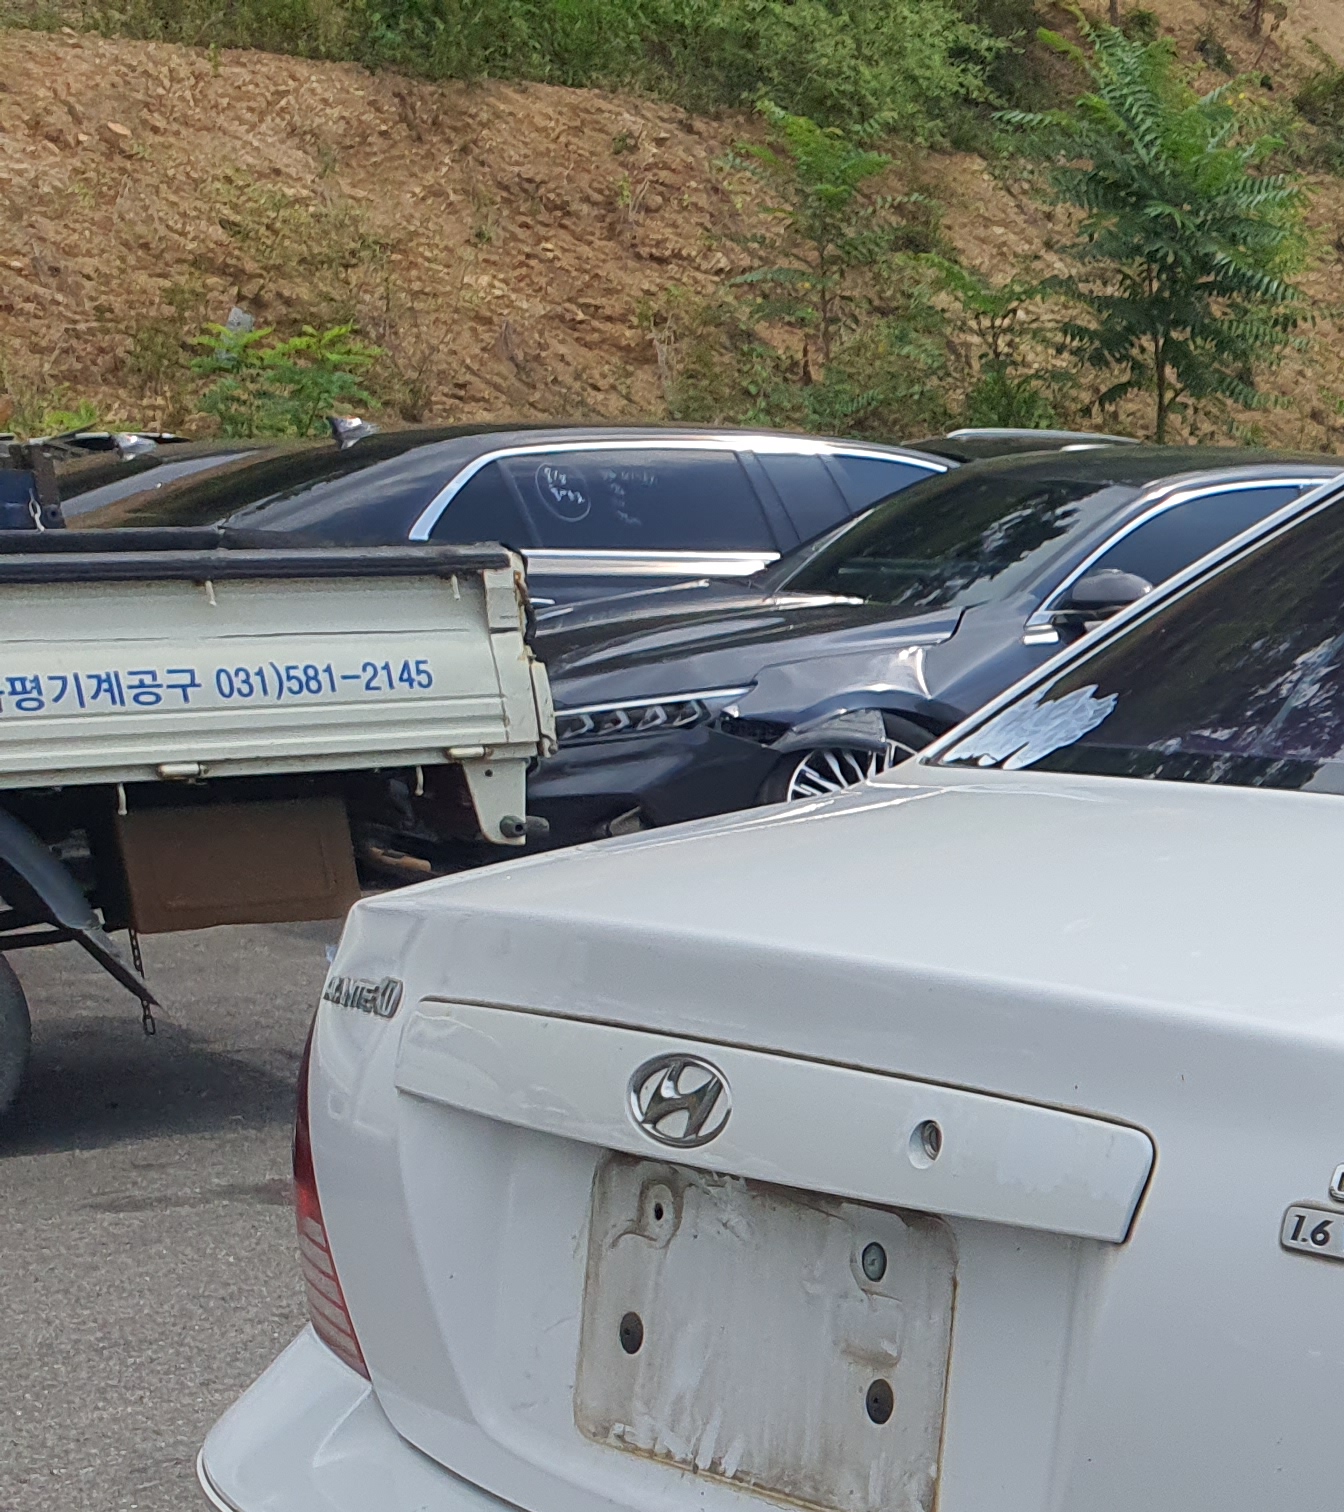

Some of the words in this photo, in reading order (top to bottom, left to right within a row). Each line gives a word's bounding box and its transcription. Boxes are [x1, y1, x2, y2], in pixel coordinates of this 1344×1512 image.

[0, 668, 202, 713] 평기계공구
[215, 657, 434, 701] 031)581-2145
[1290, 1214, 1334, 1247] 1.6
